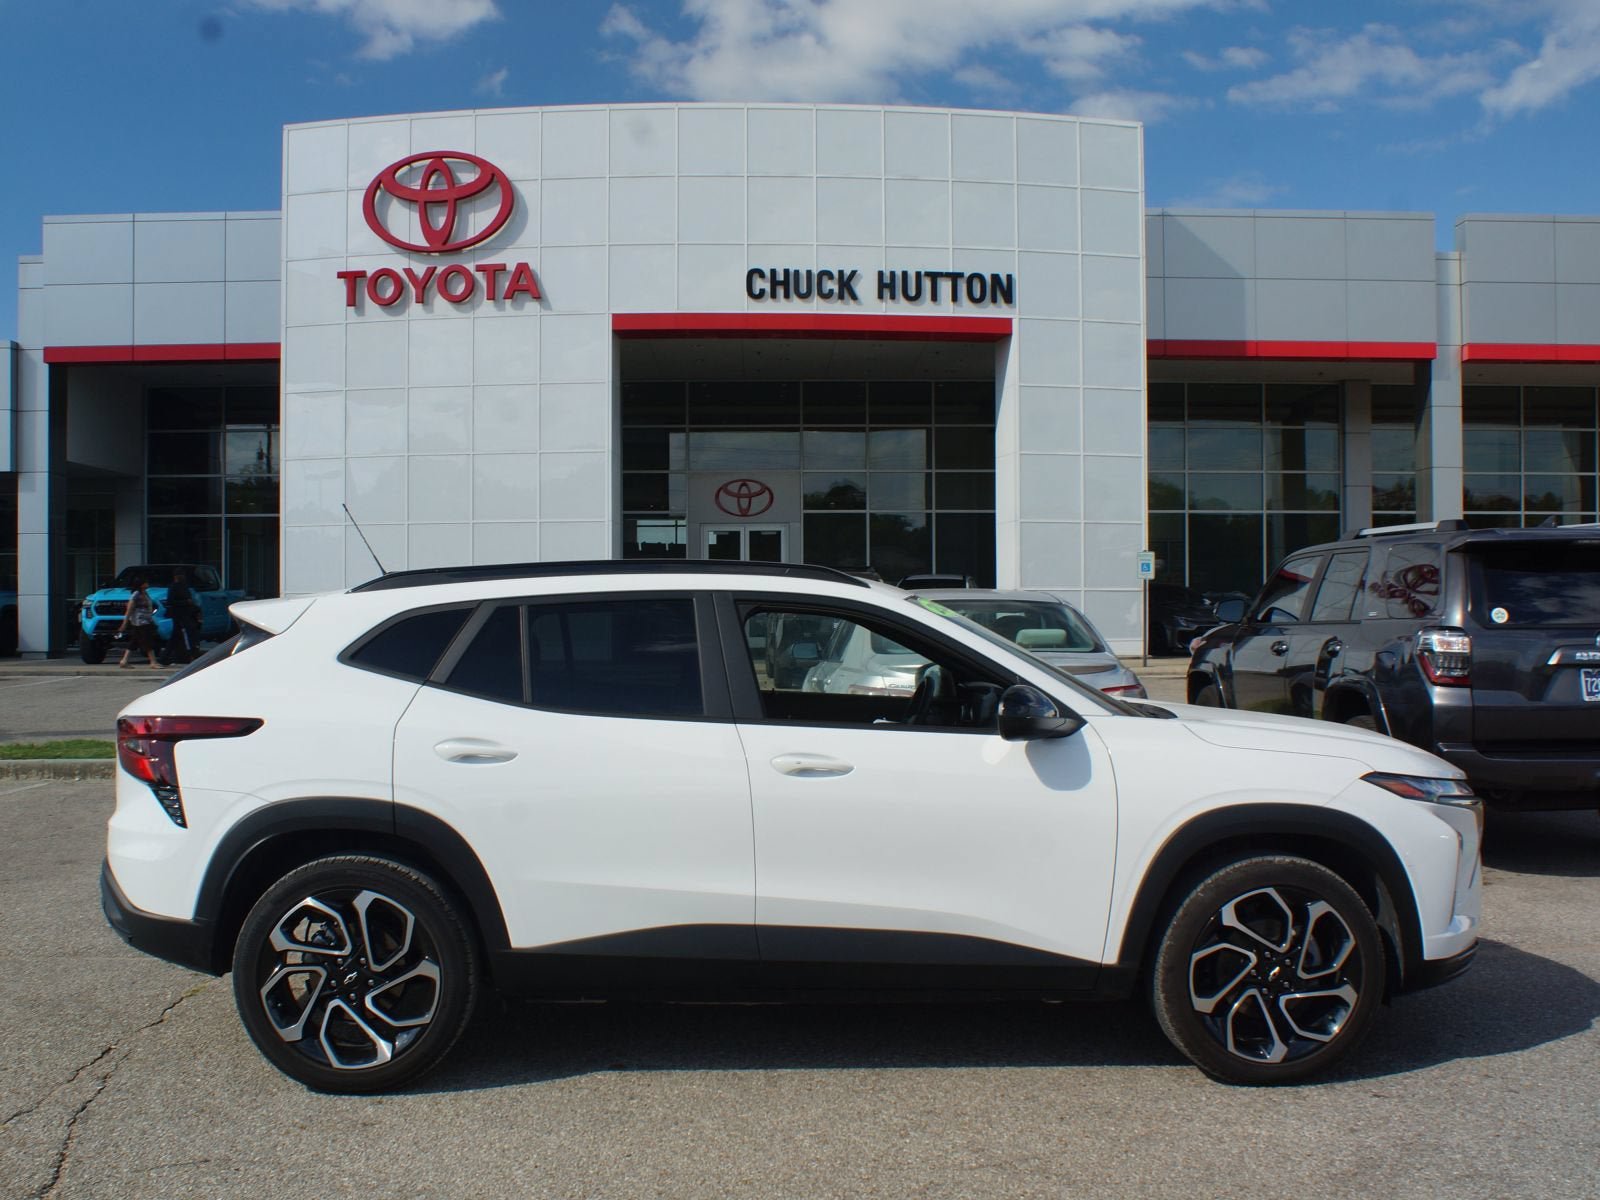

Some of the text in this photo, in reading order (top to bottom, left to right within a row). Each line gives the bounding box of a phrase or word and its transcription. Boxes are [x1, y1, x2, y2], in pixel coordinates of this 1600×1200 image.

[337, 262, 542, 307] TOYOTA
[746, 268, 1013, 304] CHUCK HUTTON
[1584, 677, 1600, 692] 72
